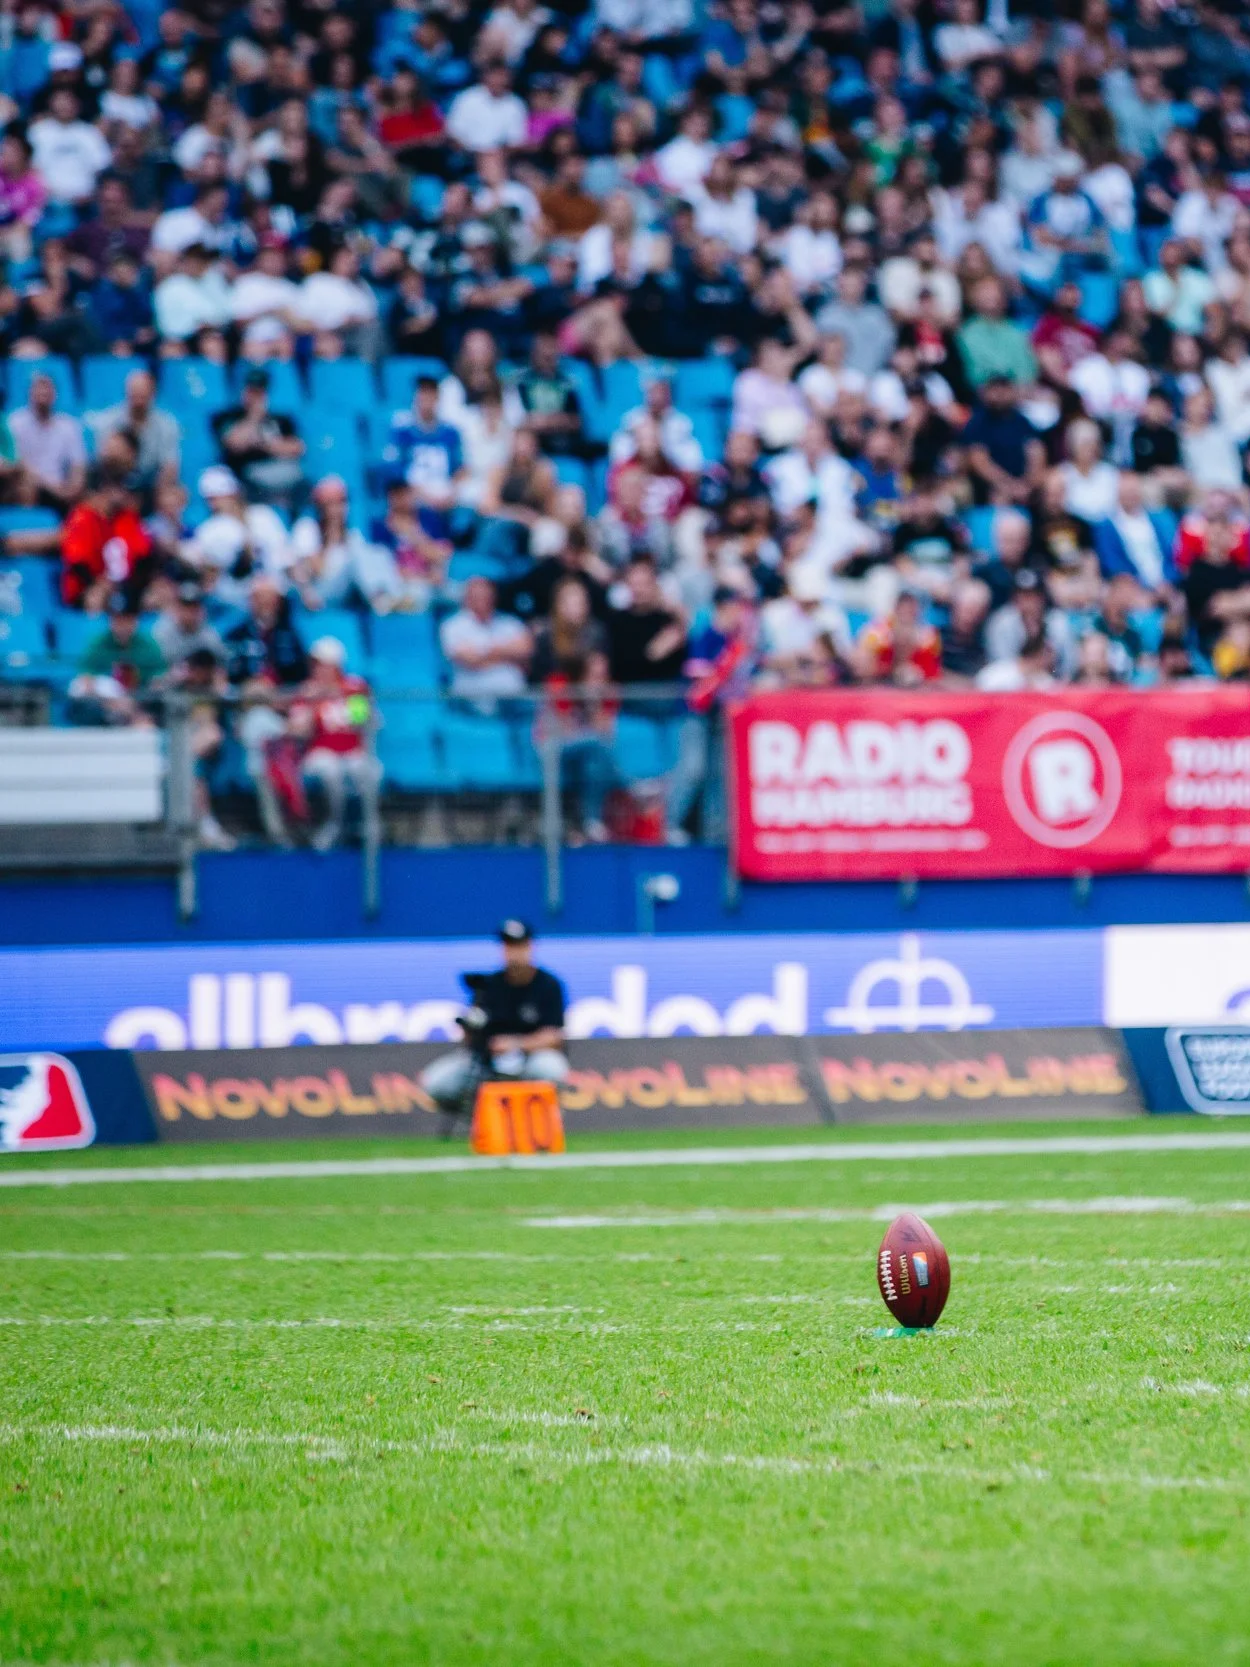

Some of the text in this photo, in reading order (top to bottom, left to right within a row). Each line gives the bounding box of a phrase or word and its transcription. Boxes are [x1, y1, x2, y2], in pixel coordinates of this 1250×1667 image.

[748, 720, 972, 787] RADIO
[1030, 739, 1100, 822] R
[752, 784, 974, 827] HAMBURG
[150, 1067, 437, 1121] NOVOLIN
[899, 1253, 912, 1296] Wilson
